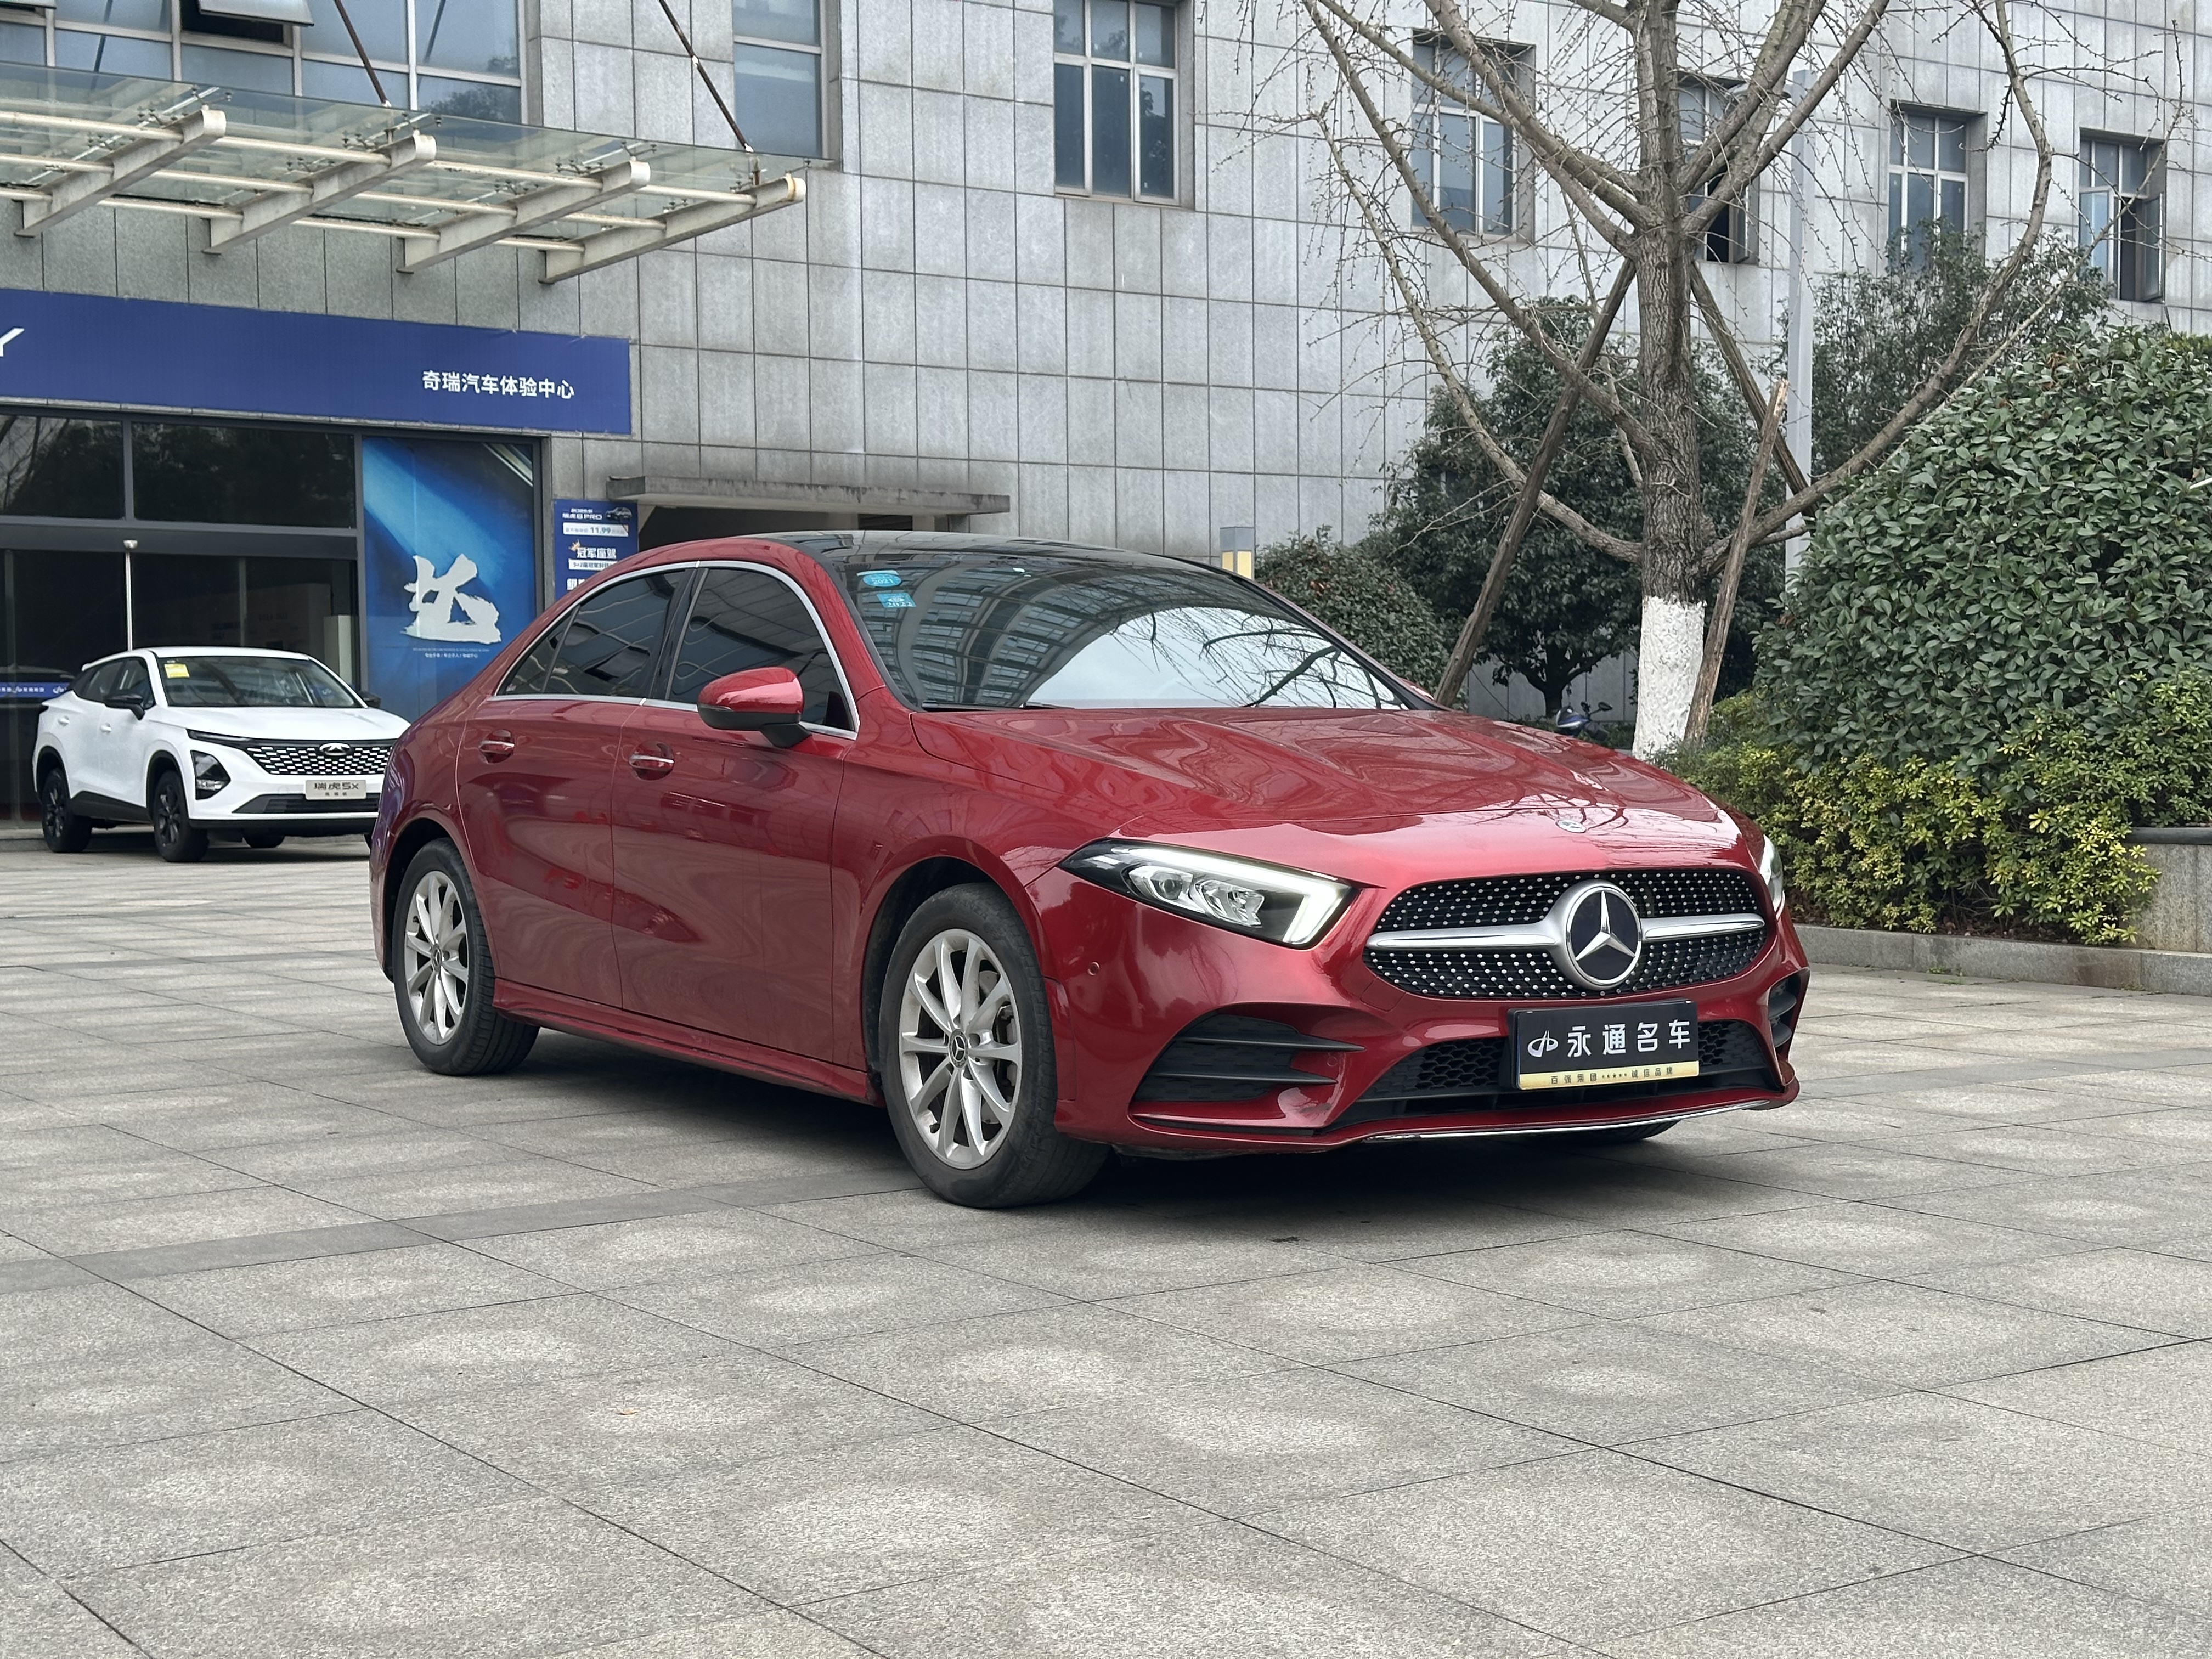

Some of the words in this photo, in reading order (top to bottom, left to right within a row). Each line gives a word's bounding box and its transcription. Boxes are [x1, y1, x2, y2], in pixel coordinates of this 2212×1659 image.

[422, 370, 575, 399] 奇瑞汽车体验中心
[1567, 1019, 1690, 1058] 永通名车
